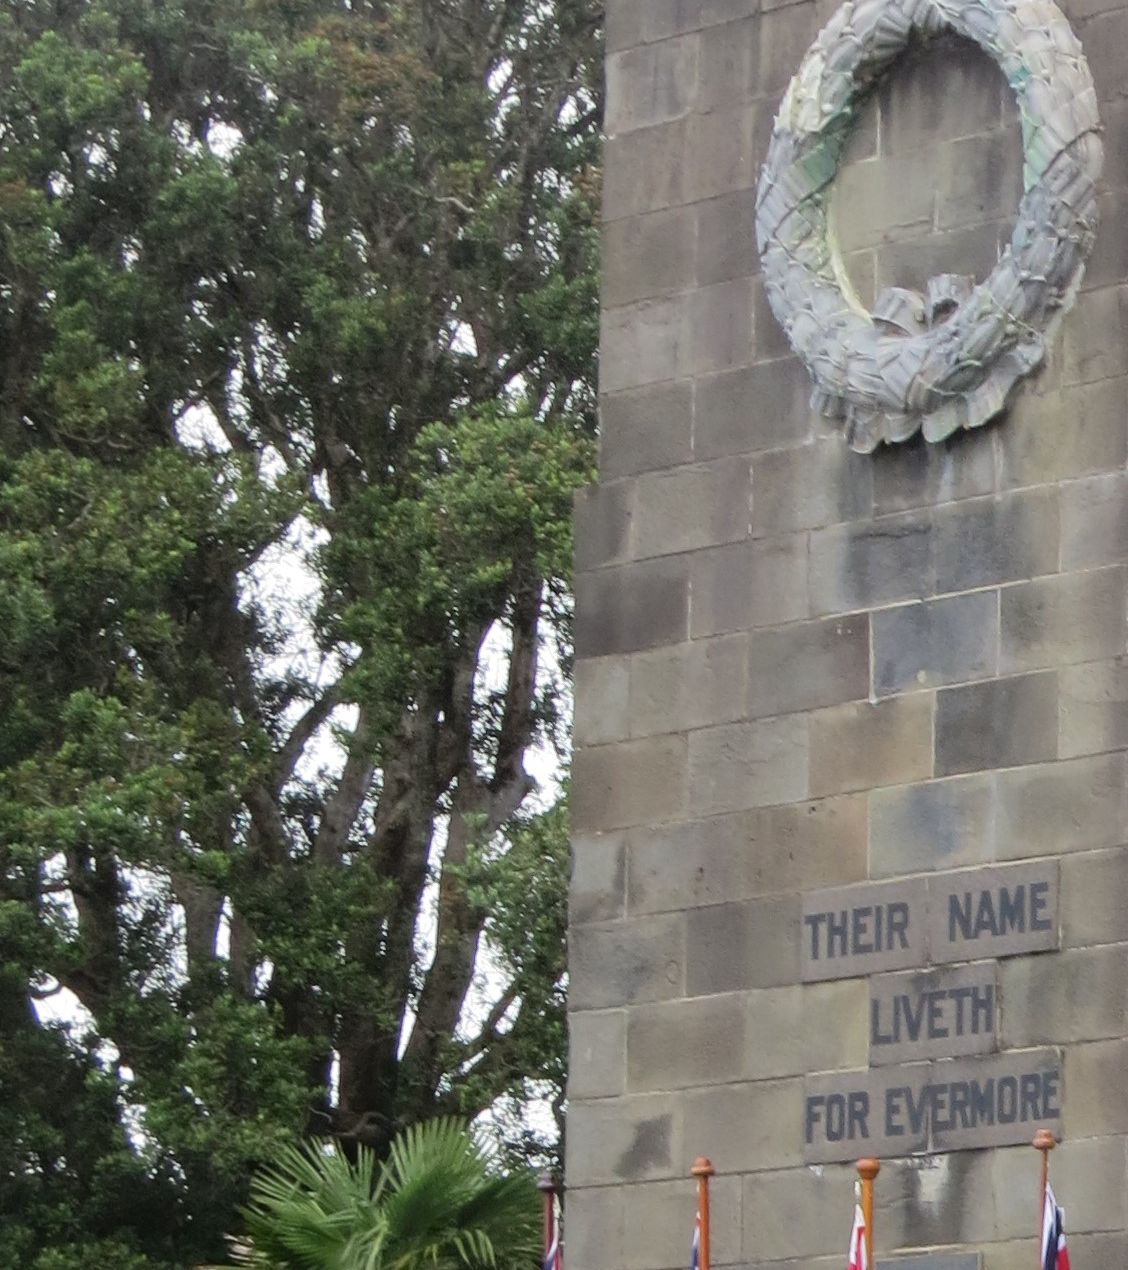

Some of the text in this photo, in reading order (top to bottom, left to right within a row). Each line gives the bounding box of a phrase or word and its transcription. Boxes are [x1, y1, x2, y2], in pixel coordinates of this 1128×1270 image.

[804, 882, 1052, 960] THEIR NAME
[871, 984, 994, 1046] LIVETH
[805, 1070, 1061, 1144] FOR EVERMORE
